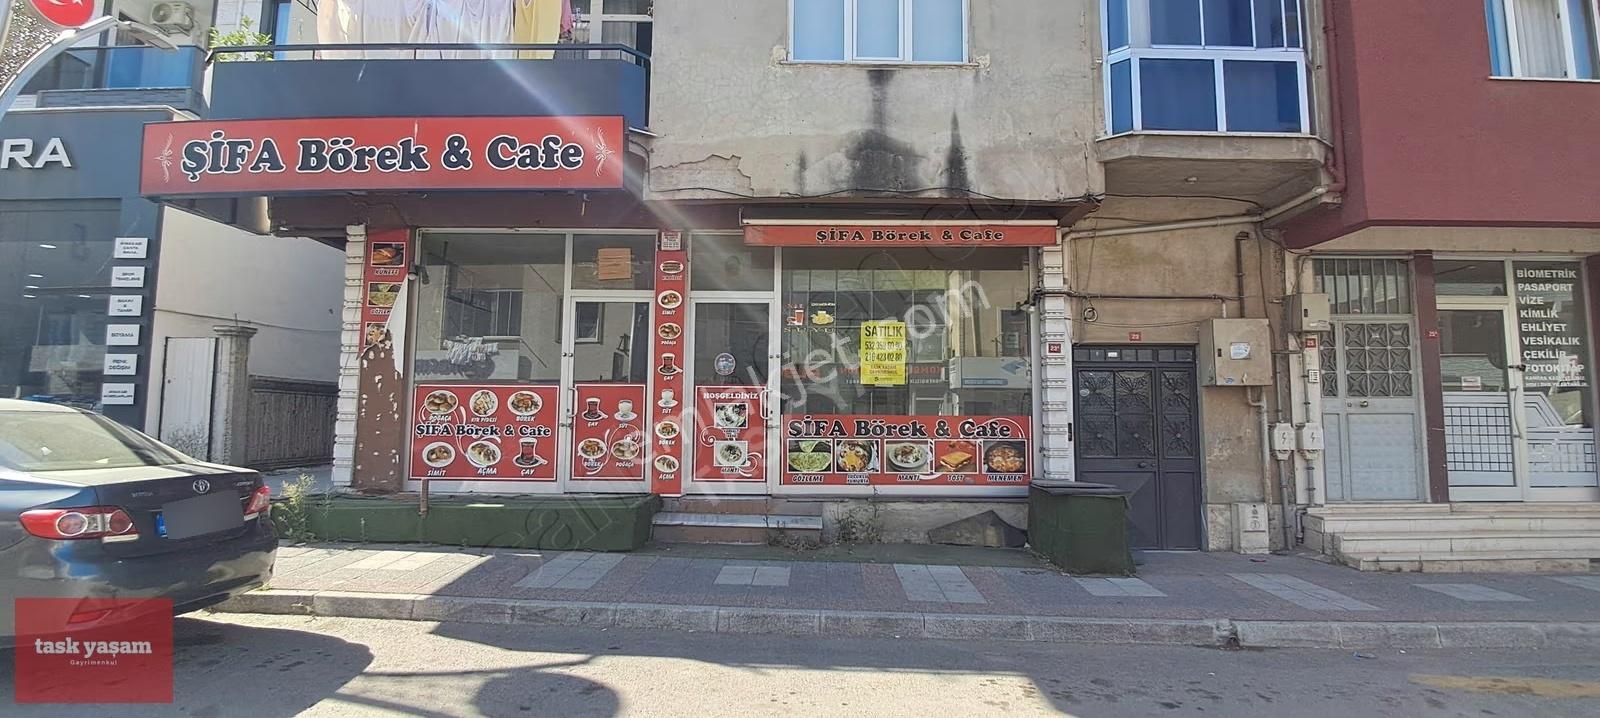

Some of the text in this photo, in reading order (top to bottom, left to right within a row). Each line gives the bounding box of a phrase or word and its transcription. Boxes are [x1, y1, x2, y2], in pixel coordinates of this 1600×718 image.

[0, 137, 72, 168] RA
[181, 130, 584, 182] ŞİFA Börek & Cafe
[816, 228, 1004, 243] ŞİFA Börek & Cafe
[1516, 268, 1577, 279] BİOMETRİK
[1517, 283, 1573, 292] PASAPORT
[1519, 296, 1544, 305] VİZE
[1520, 308, 1559, 318] KİMLİK
[864, 325, 903, 337] SATILIK
[1521, 322, 1567, 332] EHLİYET
[1522, 335, 1580, 345] VESİKALIK
[1523, 349, 1567, 361] ÇEKİLİR
[703, 391, 759, 400] HOŞGELDİNİZ
[415, 424, 551, 438] ŞİFA Börek & Cafe
[854, 419, 928, 438] Börek
[934, 419, 951, 437] &
[959, 418, 1010, 438] Cafe
[520, 468, 535, 476] ÇAY
[792, 473, 824, 483] GÖZLEME
[897, 474, 920, 482] MANTI
[947, 474, 965, 482] TOST
[987, 474, 1023, 482] MENEMEN
